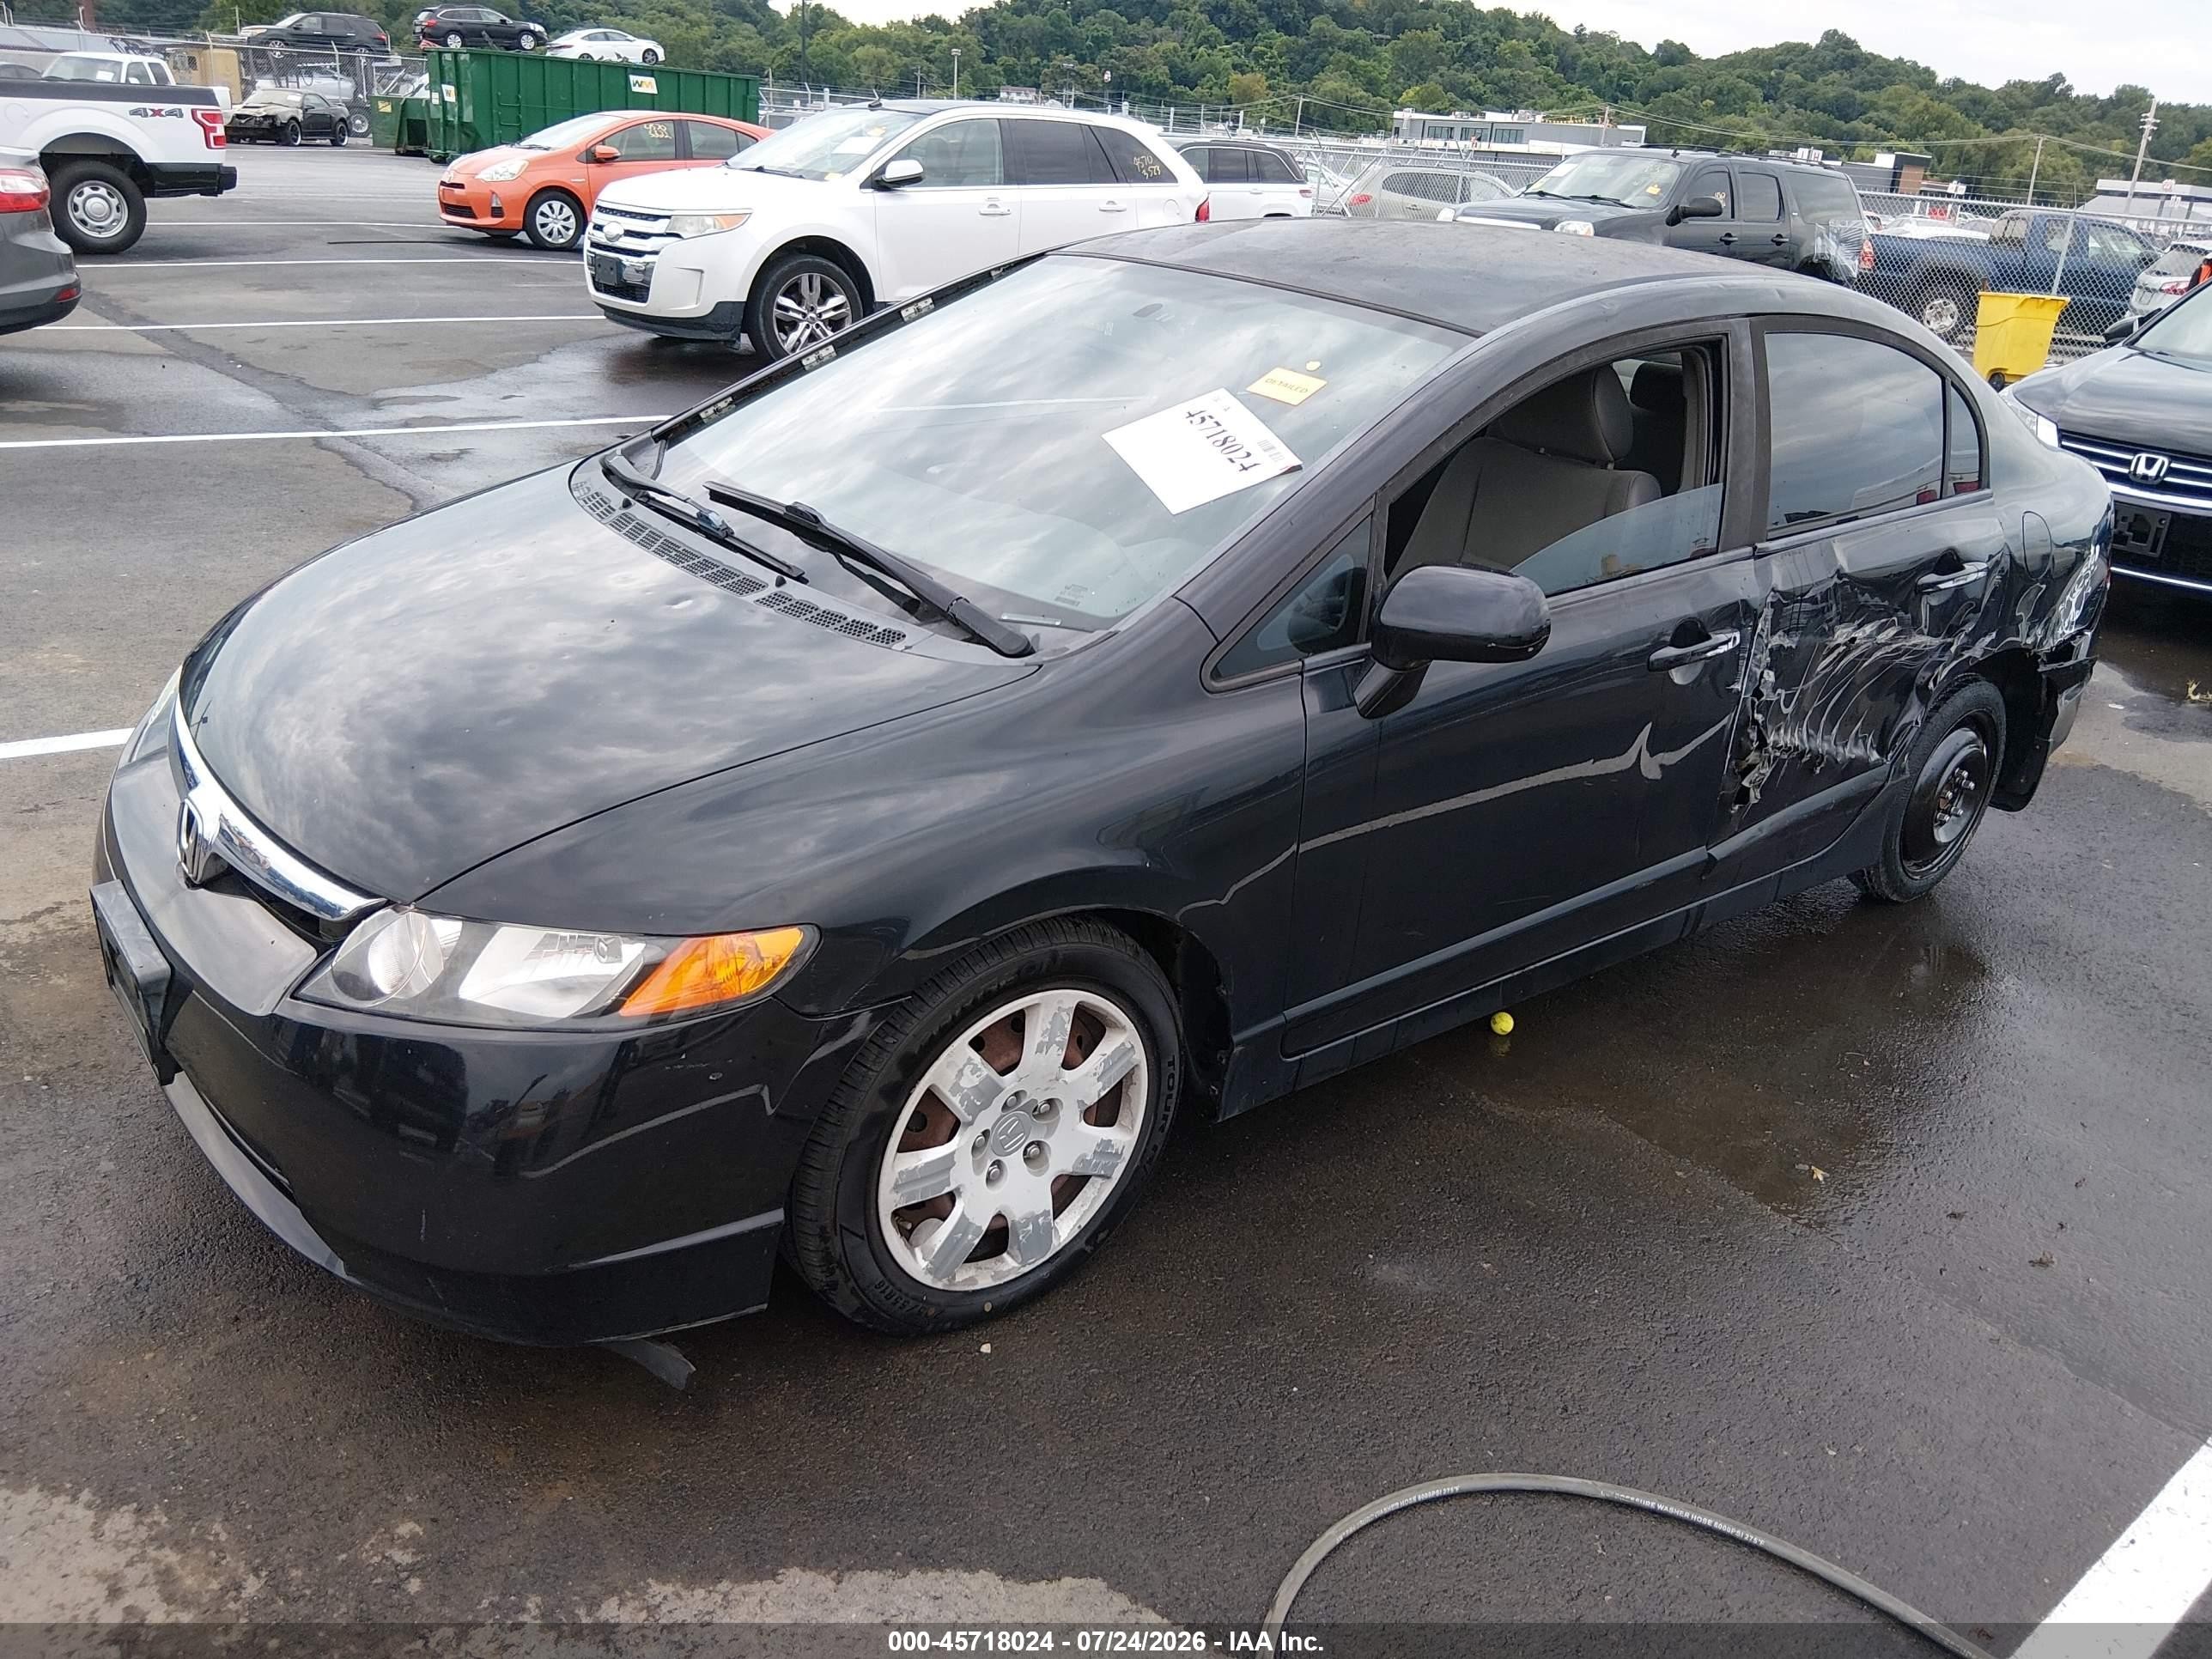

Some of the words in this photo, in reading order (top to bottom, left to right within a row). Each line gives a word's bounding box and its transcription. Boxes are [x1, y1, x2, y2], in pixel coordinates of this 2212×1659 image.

[1265, 378, 1309, 393] DETAILED
[1186, 410, 1261, 472] 45718024
[1158, 1054, 1176, 1133] TOUR
